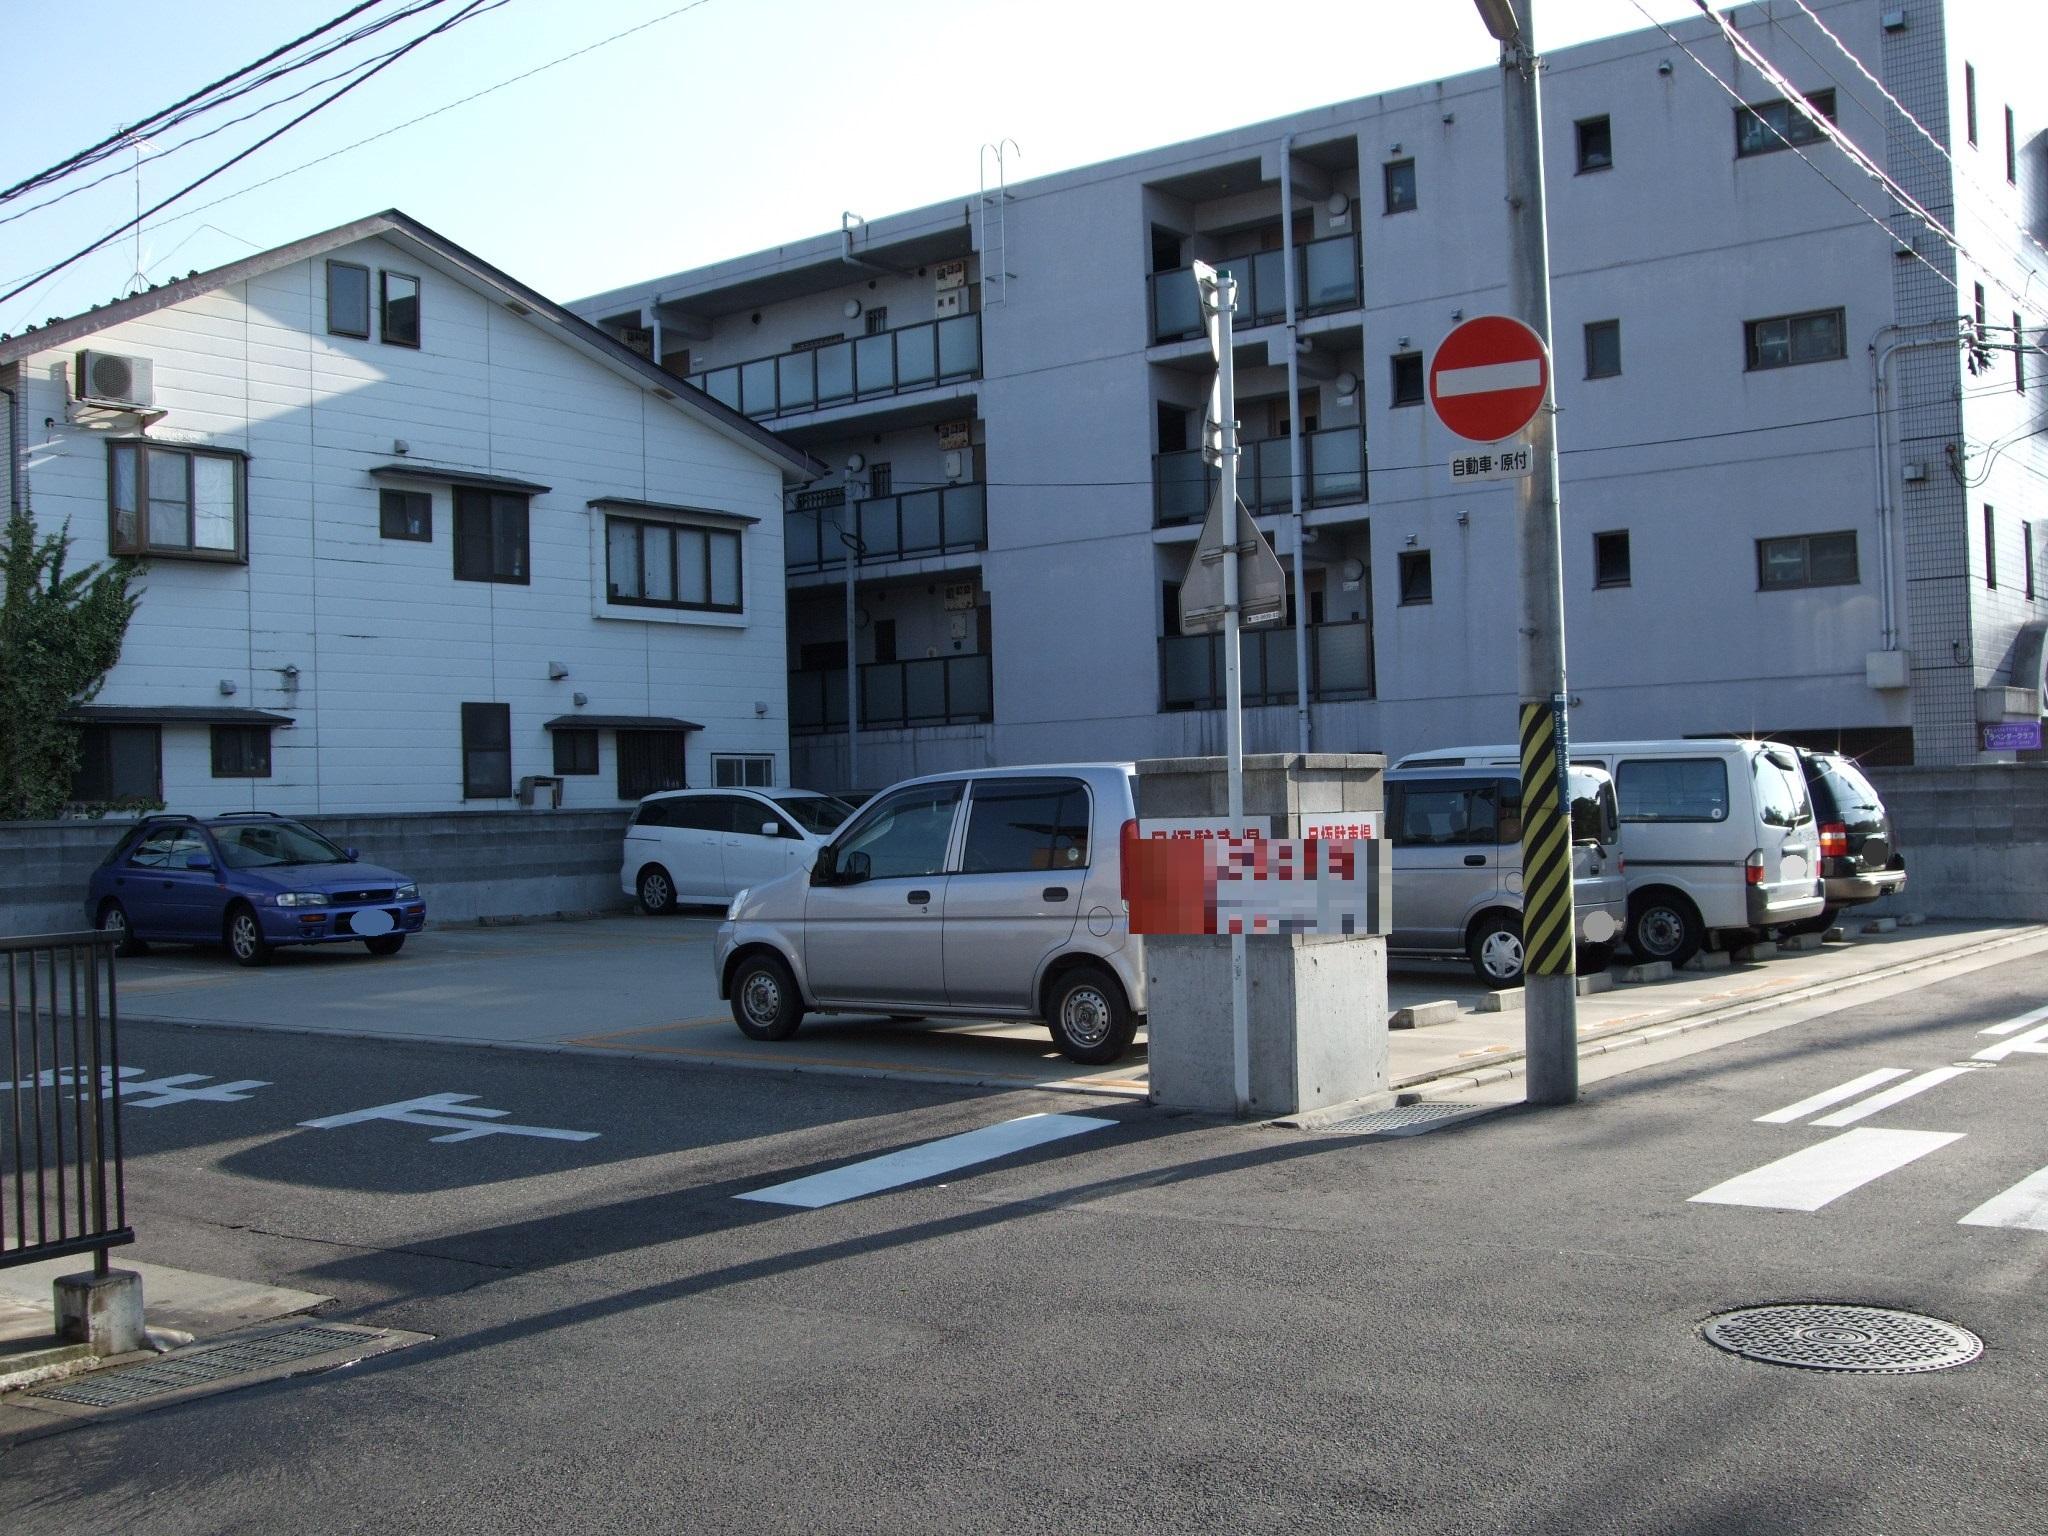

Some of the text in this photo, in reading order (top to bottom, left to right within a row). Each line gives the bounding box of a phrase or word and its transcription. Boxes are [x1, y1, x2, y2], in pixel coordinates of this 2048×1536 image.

[1453, 451, 1527, 477] 自動車・原付
